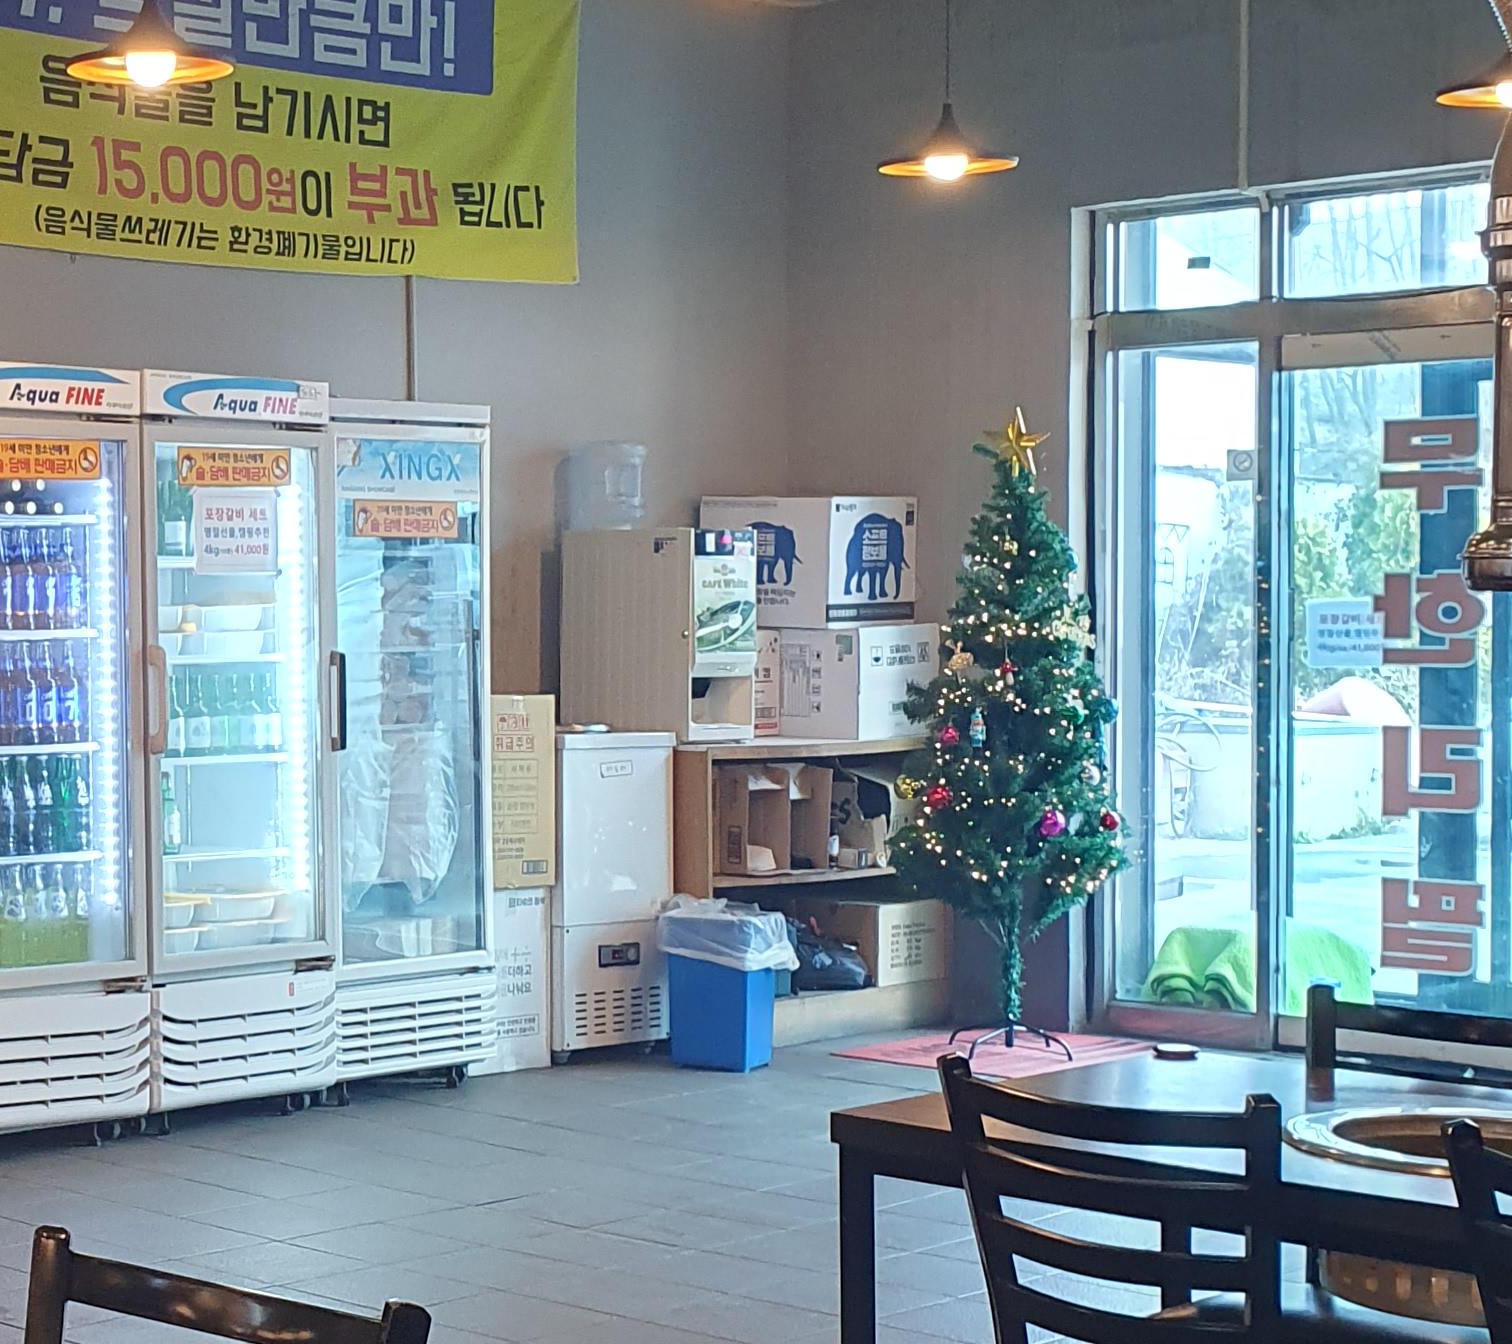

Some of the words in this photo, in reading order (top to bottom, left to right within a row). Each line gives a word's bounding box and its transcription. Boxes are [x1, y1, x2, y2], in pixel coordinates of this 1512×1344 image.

[234, 80, 391, 147] 남기시면
[347, 162, 438, 226] 부과
[451, 182, 545, 229] 됩니다
[35, 205, 219, 251] (음식물쓰레기는
[228, 225, 416, 265] 환경폐기물입니다)
[9, 383, 60, 406] Aqua
[65, 387, 106, 406] FINE
[213, 393, 258, 414] Aqua
[263, 396, 298, 415] FINE
[34, 458, 78, 475] 판매금지
[232, 466, 271, 482] 판매금지
[204, 506, 244, 522] 포장갈비
